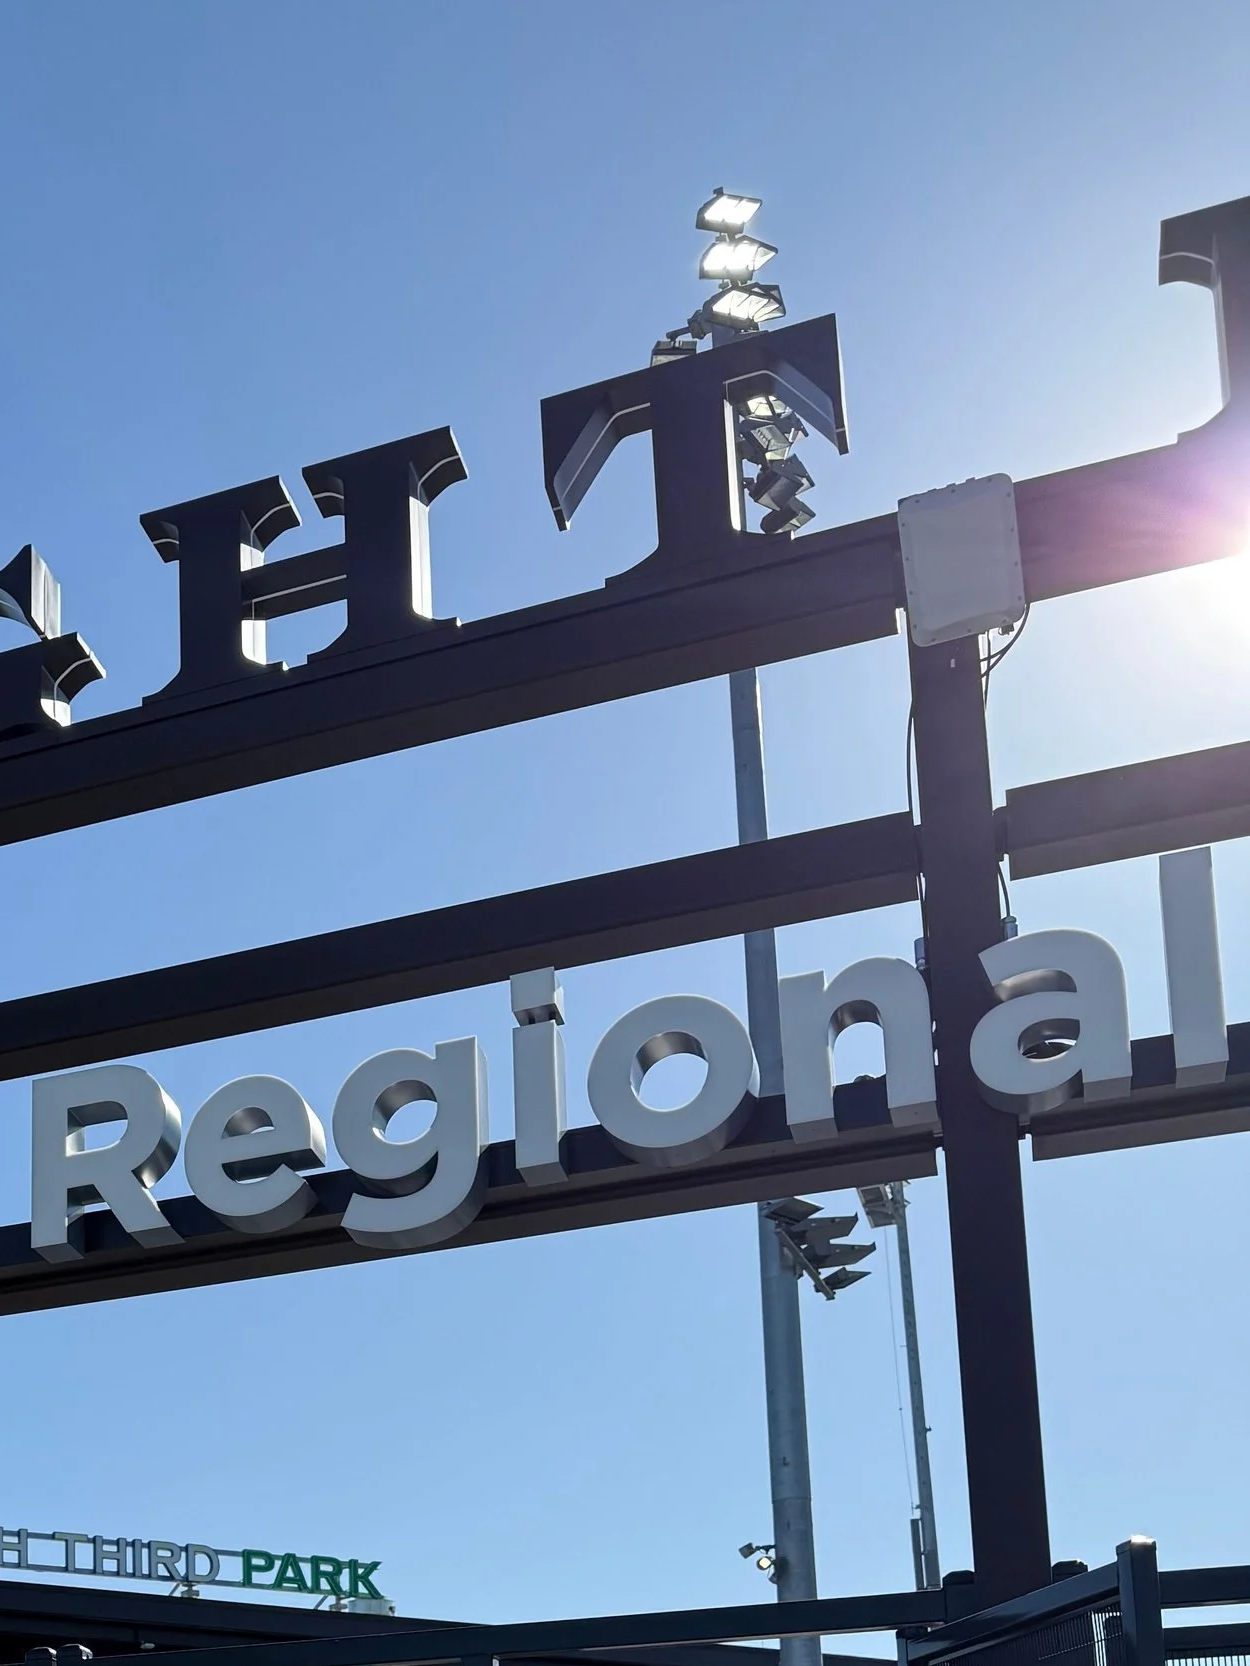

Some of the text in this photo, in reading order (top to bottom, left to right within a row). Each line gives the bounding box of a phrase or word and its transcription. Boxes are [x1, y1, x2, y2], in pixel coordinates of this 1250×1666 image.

[30, 846, 1229, 1264] Regional
[52, 1531, 221, 1584] THIRD
[241, 1548, 383, 1600] PARK
